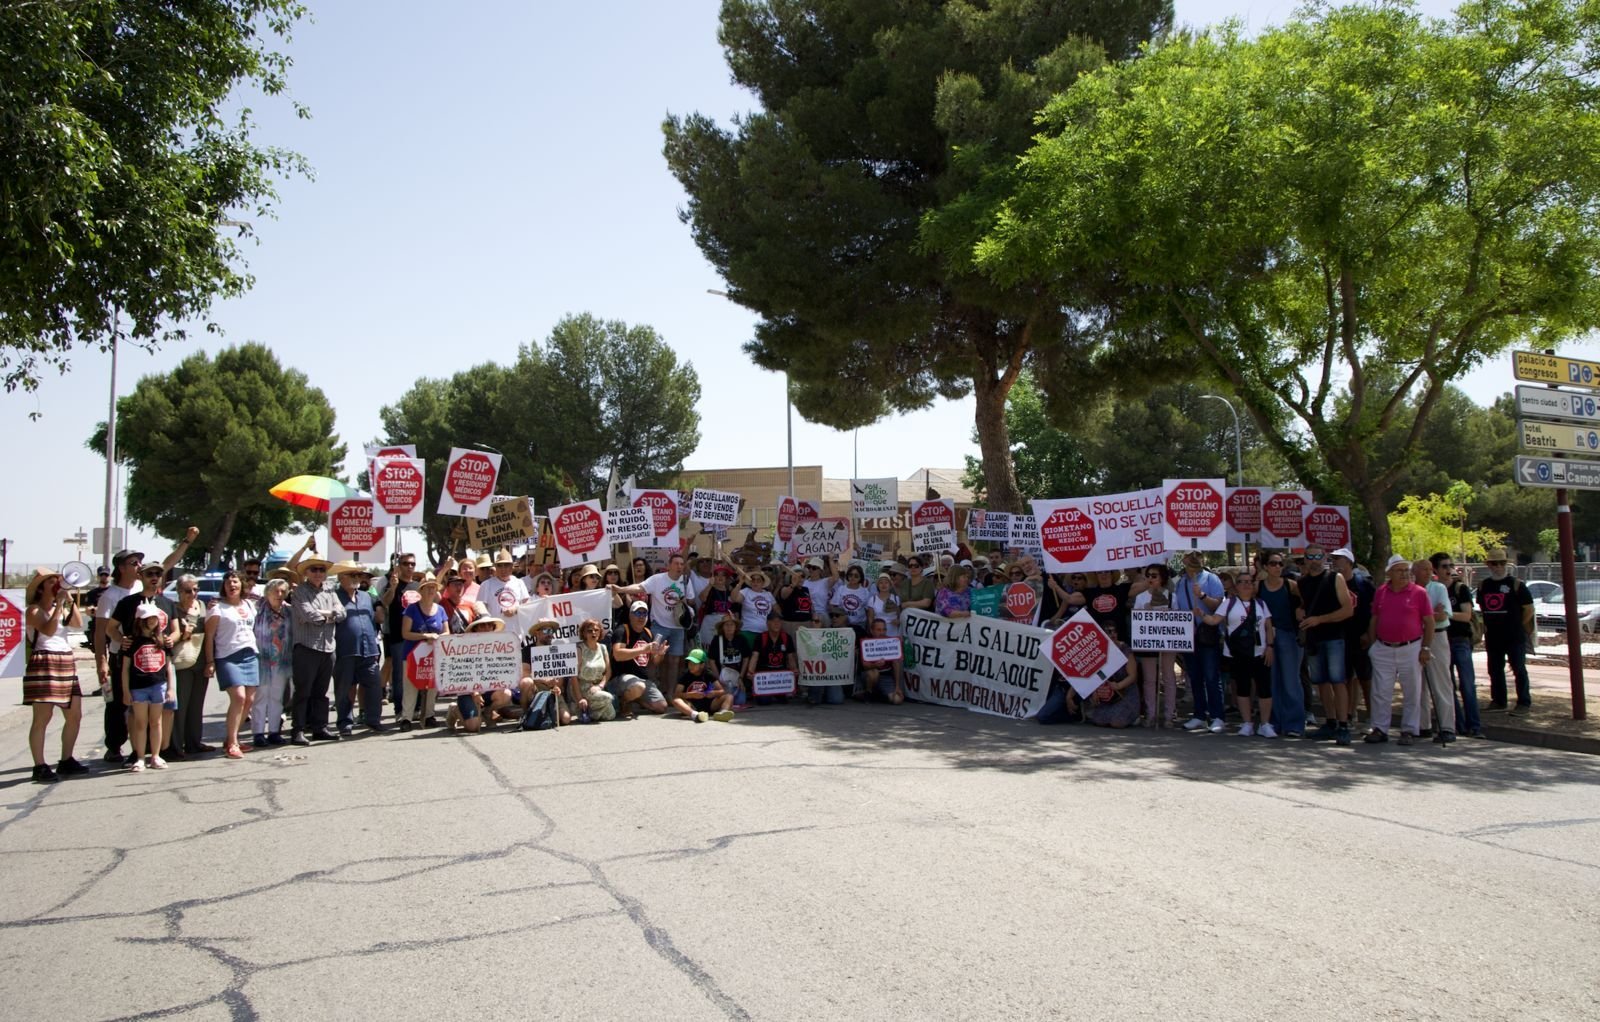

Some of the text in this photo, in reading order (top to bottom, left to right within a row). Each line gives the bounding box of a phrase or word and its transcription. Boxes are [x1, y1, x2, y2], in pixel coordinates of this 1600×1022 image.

[1518, 355, 1557, 368] palacio de
[1519, 366, 1558, 379] congresos
[1522, 397, 1558, 408] centro ciudad
[1524, 423, 1542, 433] hotel
[1526, 434, 1557, 450] Beatriz
[459, 458, 490, 472] STOP
[385, 467, 415, 480] STOP
[452, 471, 491, 482] BIOMETANO
[380, 481, 420, 489] BIOMETANO
[458, 480, 488, 489] RESIDUOS
[455, 486, 482, 496] MÉDICOS
[1176, 488, 1212, 501] STOP
[385, 496, 413, 504] MÉDICOS
[641, 496, 669, 508] STOP
[1233, 494, 1261, 504] STOP
[1271, 499, 1302, 509] STOP
[493, 504, 505, 514] ES
[694, 501, 703, 510] NO
[704, 502, 712, 511] SE
[782, 503, 795, 513] STOP
[920, 506, 946, 516] STOP
[1171, 502, 1218, 510] BIOMETANO
[342, 506, 373, 518] STOP
[561, 509, 591, 524] STOP
[620, 508, 646, 517] OLOR,
[1050, 510, 1081, 524] STOP
[1179, 510, 1215, 518] RESIDUOS
[336, 518, 373, 526] BIOMETAN
[608, 515, 648, 526] NI RUIDO,
[918, 516, 951, 524] BIOMETANO
[1098, 514, 1138, 531] NO SE
[1178, 517, 1210, 526] MÉDICOS
[1312, 513, 1340, 524] STOP
[476, 524, 513, 539] ES UNA
[559, 520, 598, 534] BIOMETANO
[606, 527, 615, 535] NI
[811, 522, 824, 531] LA
[1044, 523, 1092, 535] BIOMETANO
[1309, 524, 1345, 532] BIOMETANO
[342, 533, 372, 541] MÉDICOS
[567, 527, 598, 538] RESIDUOS
[802, 530, 836, 543] GRAN
[924, 530, 931, 538] ES
[1047, 531, 1081, 540] RESIDUOS
[1134, 528, 1153, 543] SE
[567, 535, 595, 546] MÉDICOS
[923, 535, 943, 545] ES UNA
[796, 541, 842, 556] CAGADA
[1008, 592, 1033, 607] STOP
[552, 601, 573, 618] NO
[981, 606, 992, 614] NO
[1133, 612, 1192, 622] NO ES PROGRESO
[1140, 626, 1186, 636] SI ENVENENA
[905, 614, 1041, 661] POR LA SALUD
[1055, 624, 1085, 653] STOP
[441, 640, 515, 657] VALDEPEÑAS
[1060, 630, 1098, 665] BIOMETANO
[1133, 640, 1192, 650] NUESTRA TIERRA
[552, 651, 577, 660] ENERGÍA
[831, 652, 849, 661] que
[1071, 638, 1101, 665] RESIDUOS
[543, 660, 566, 669] ES UNA
[1075, 648, 1102, 672] MÉDICOS
[802, 660, 827, 674] NO
[911, 643, 945, 669] DEL
[954, 649, 1044, 692] BULLAQUE
[904, 671, 921, 692] NO
